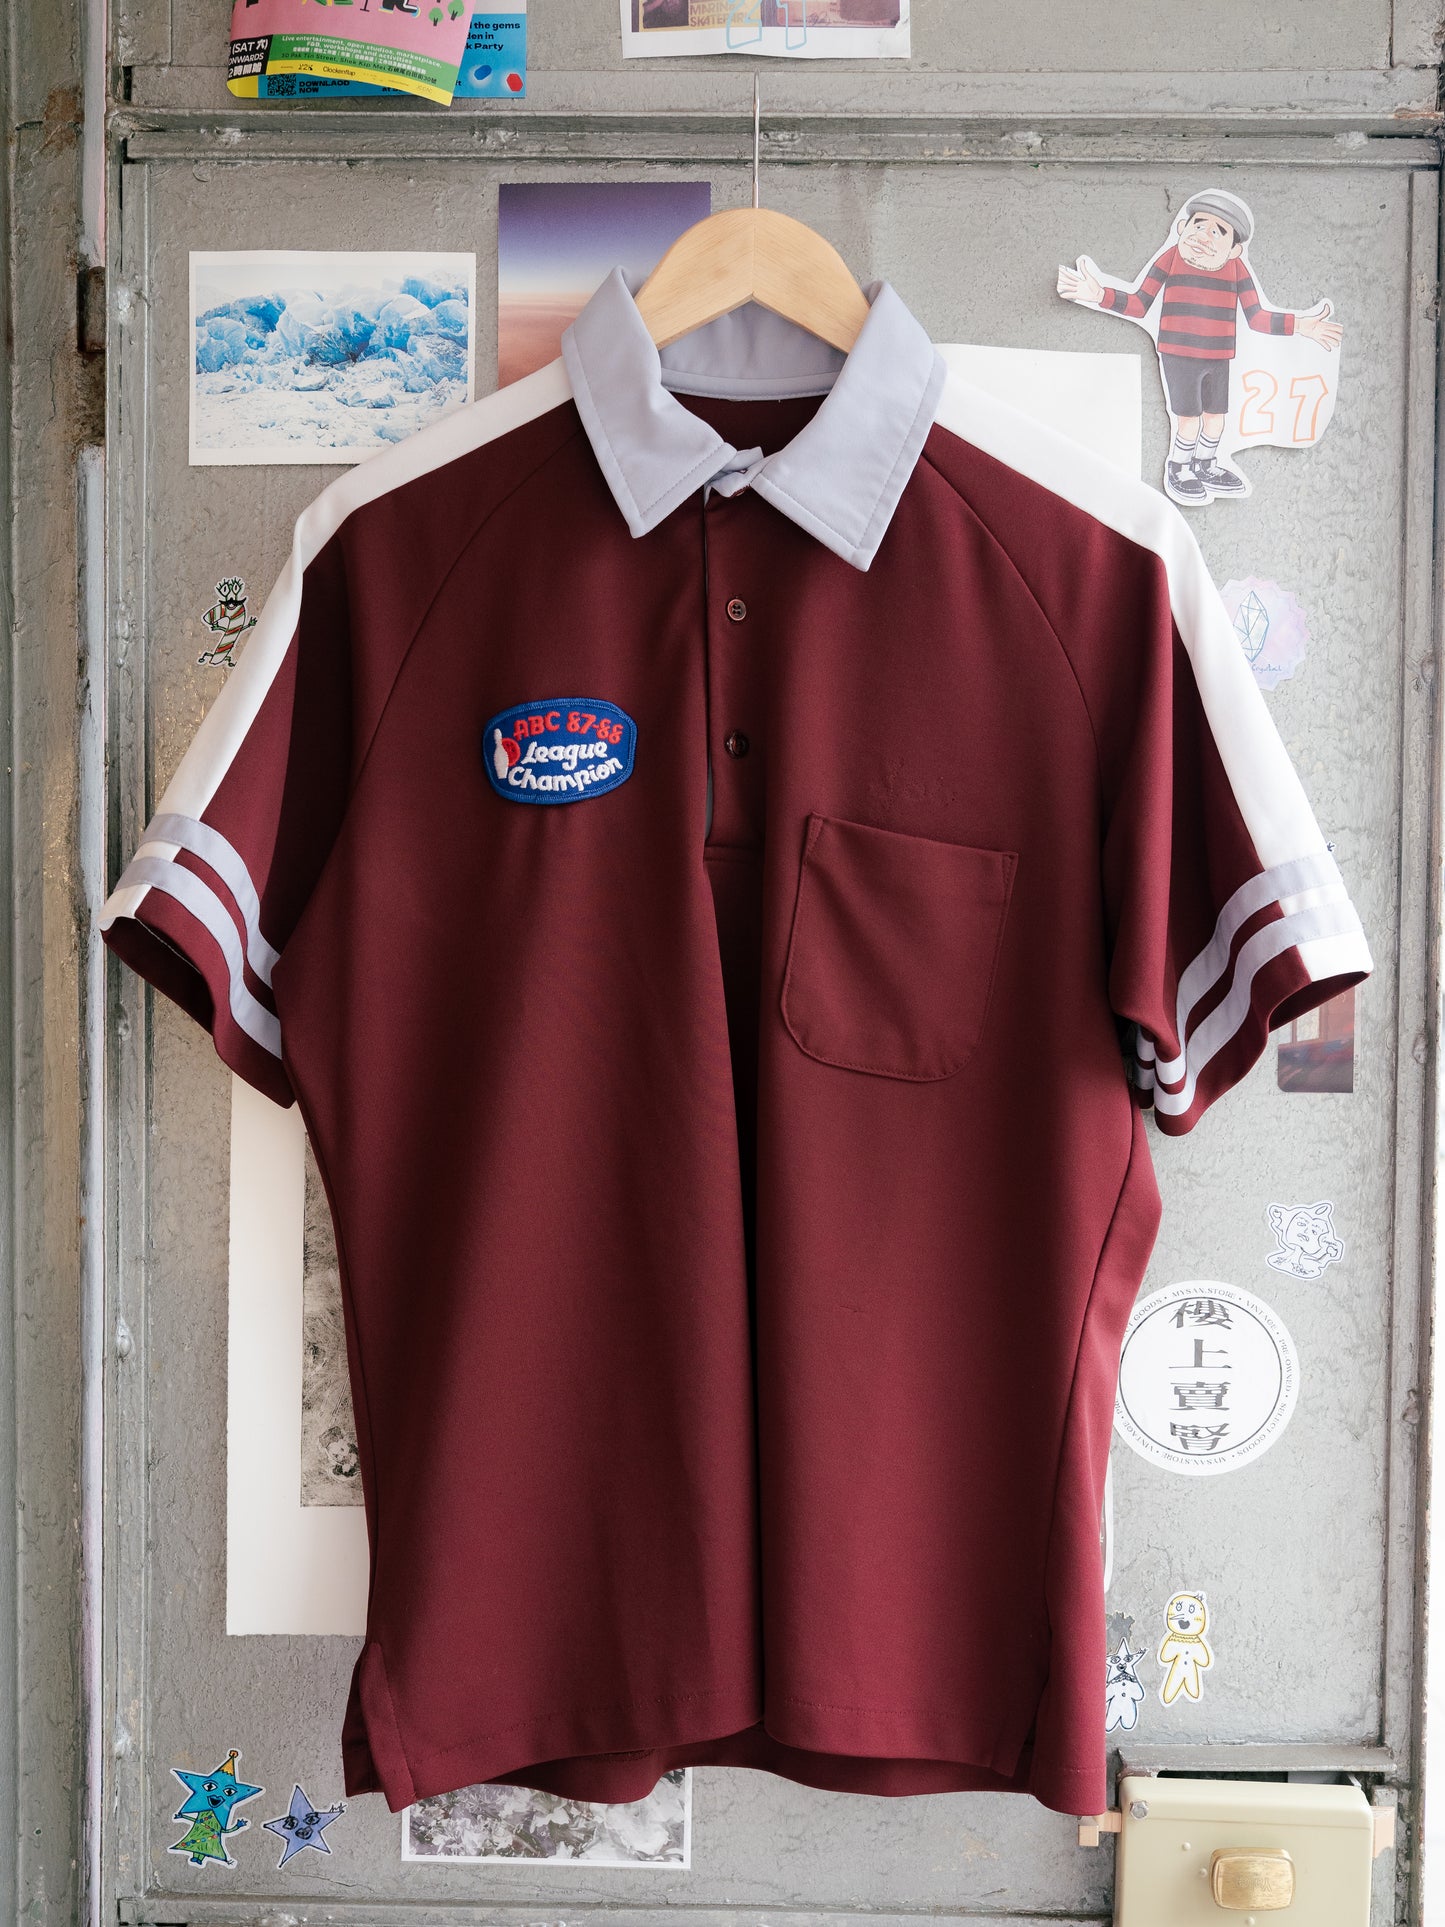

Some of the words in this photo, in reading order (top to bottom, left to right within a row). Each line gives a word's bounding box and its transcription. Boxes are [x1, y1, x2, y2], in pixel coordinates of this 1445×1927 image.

[474, 21, 490, 29] the
[492, 22, 520, 31] gems
[690, 12, 750, 27] SKATEPAR
[485, 31, 494, 40] in
[232, 42, 255, 55] (SAT
[347, 42, 364, 50] open
[474, 43, 504, 51] Party
[324, 43, 361, 54] workshops
[379, 52, 413, 64] activities
[340, 57, 357, 65] Shek
[323, 66, 356, 77] Clockenflap
[1239, 369, 1328, 442] 27
[513, 711, 560, 741] ABC
[567, 711, 624, 744] 87-88
[521, 741, 608, 771] League
[508, 757, 623, 791] Champion
[1133, 1298, 1162, 1321] GOODS
